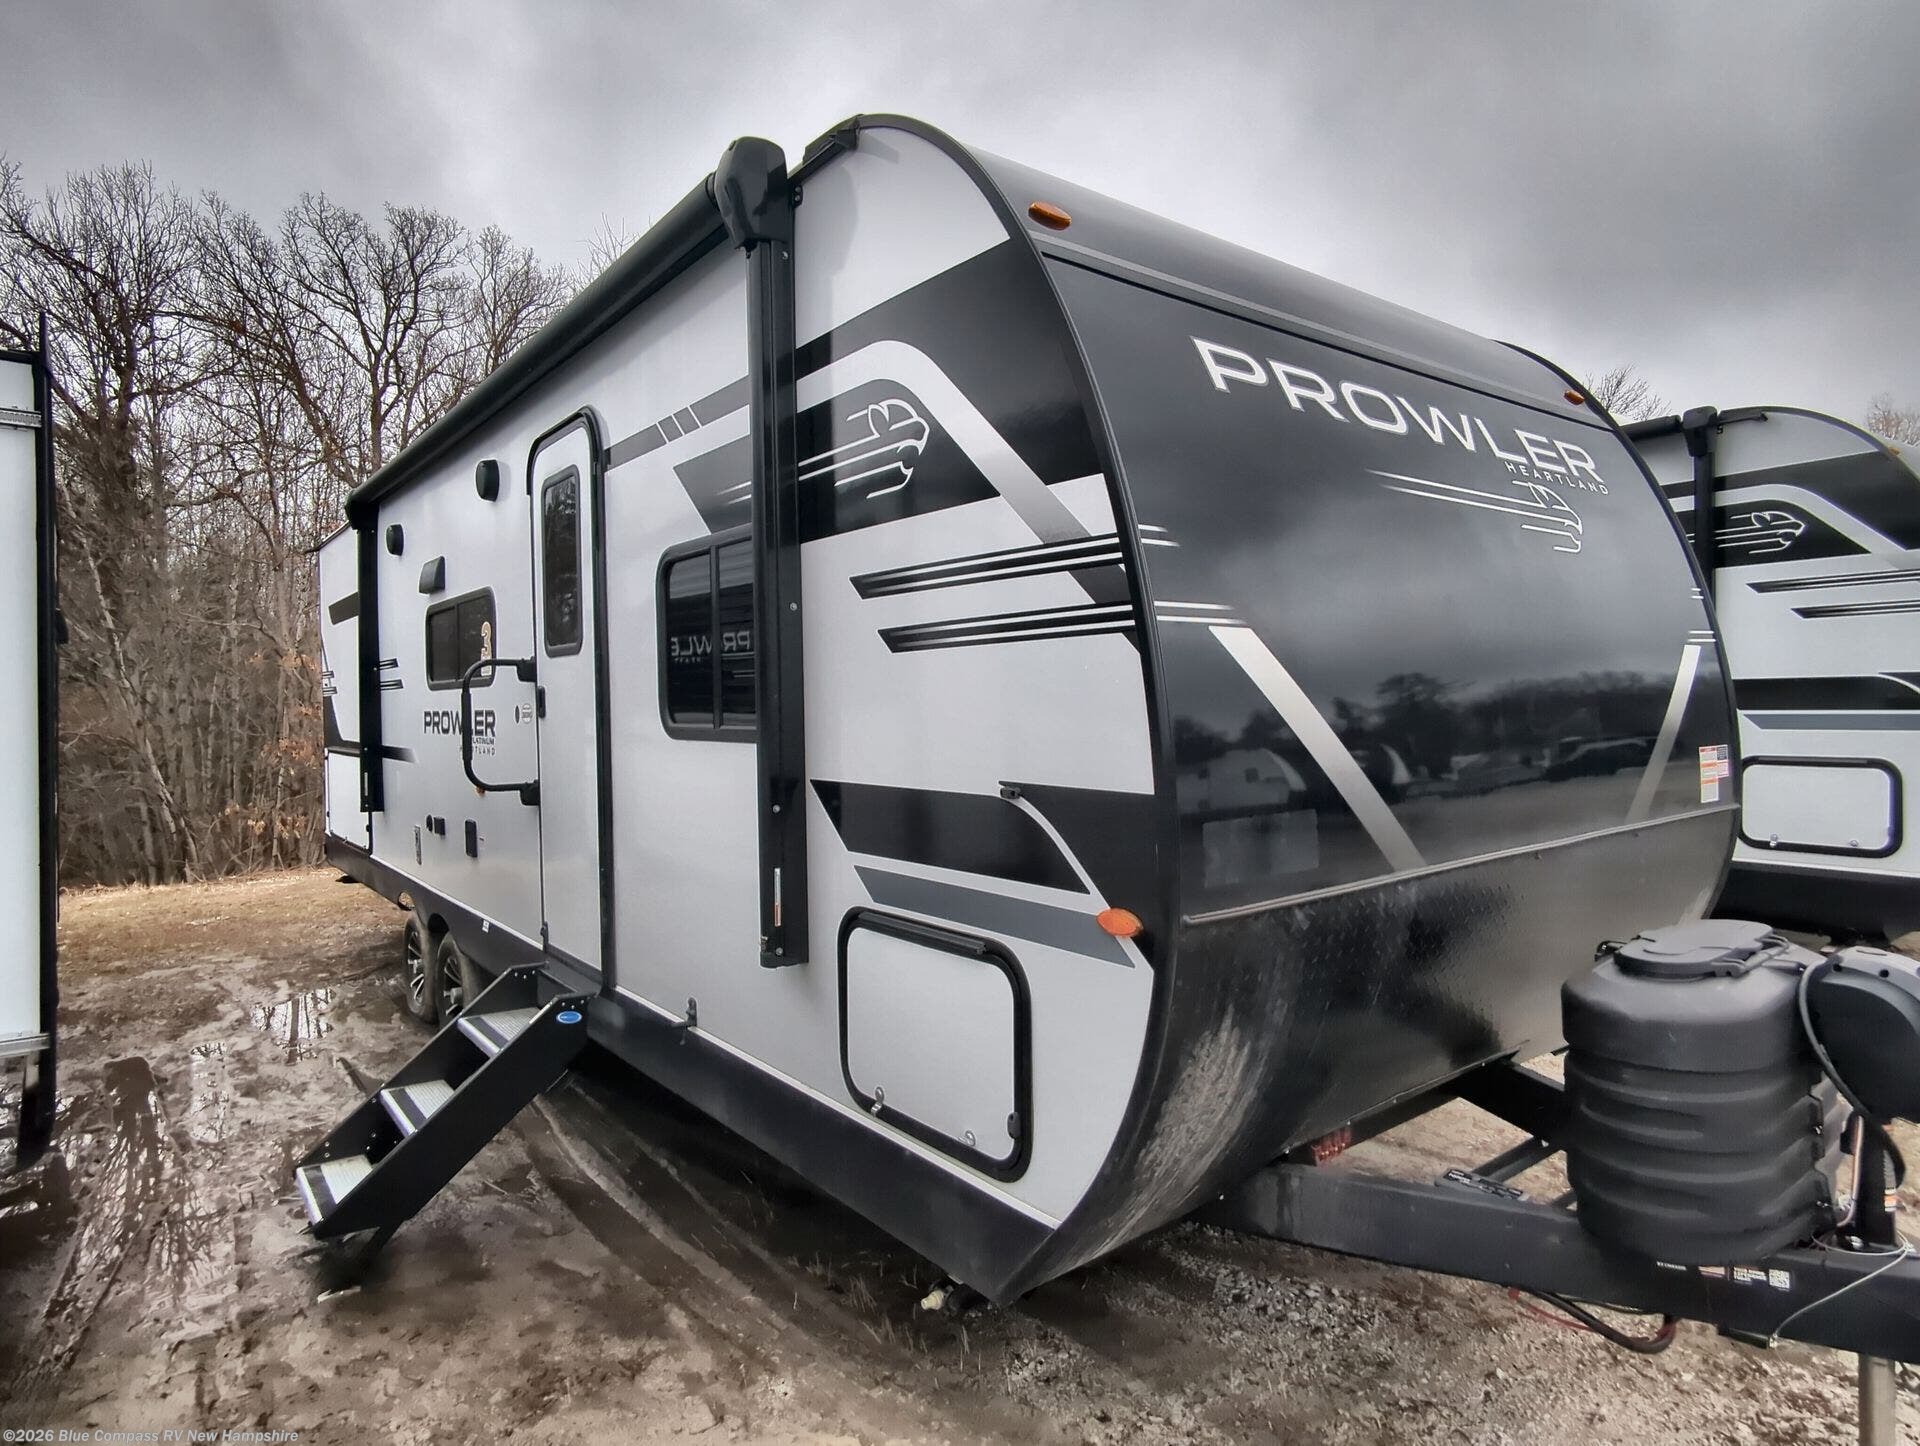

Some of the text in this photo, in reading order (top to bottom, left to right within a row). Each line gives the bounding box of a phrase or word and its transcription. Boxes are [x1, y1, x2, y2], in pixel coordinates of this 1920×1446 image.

[1191, 337, 1605, 483] PROWLER
[1504, 461, 1609, 495] HEARTLAND
[424, 709, 496, 737] PROWER
[472, 737, 495, 746] LATINUM
